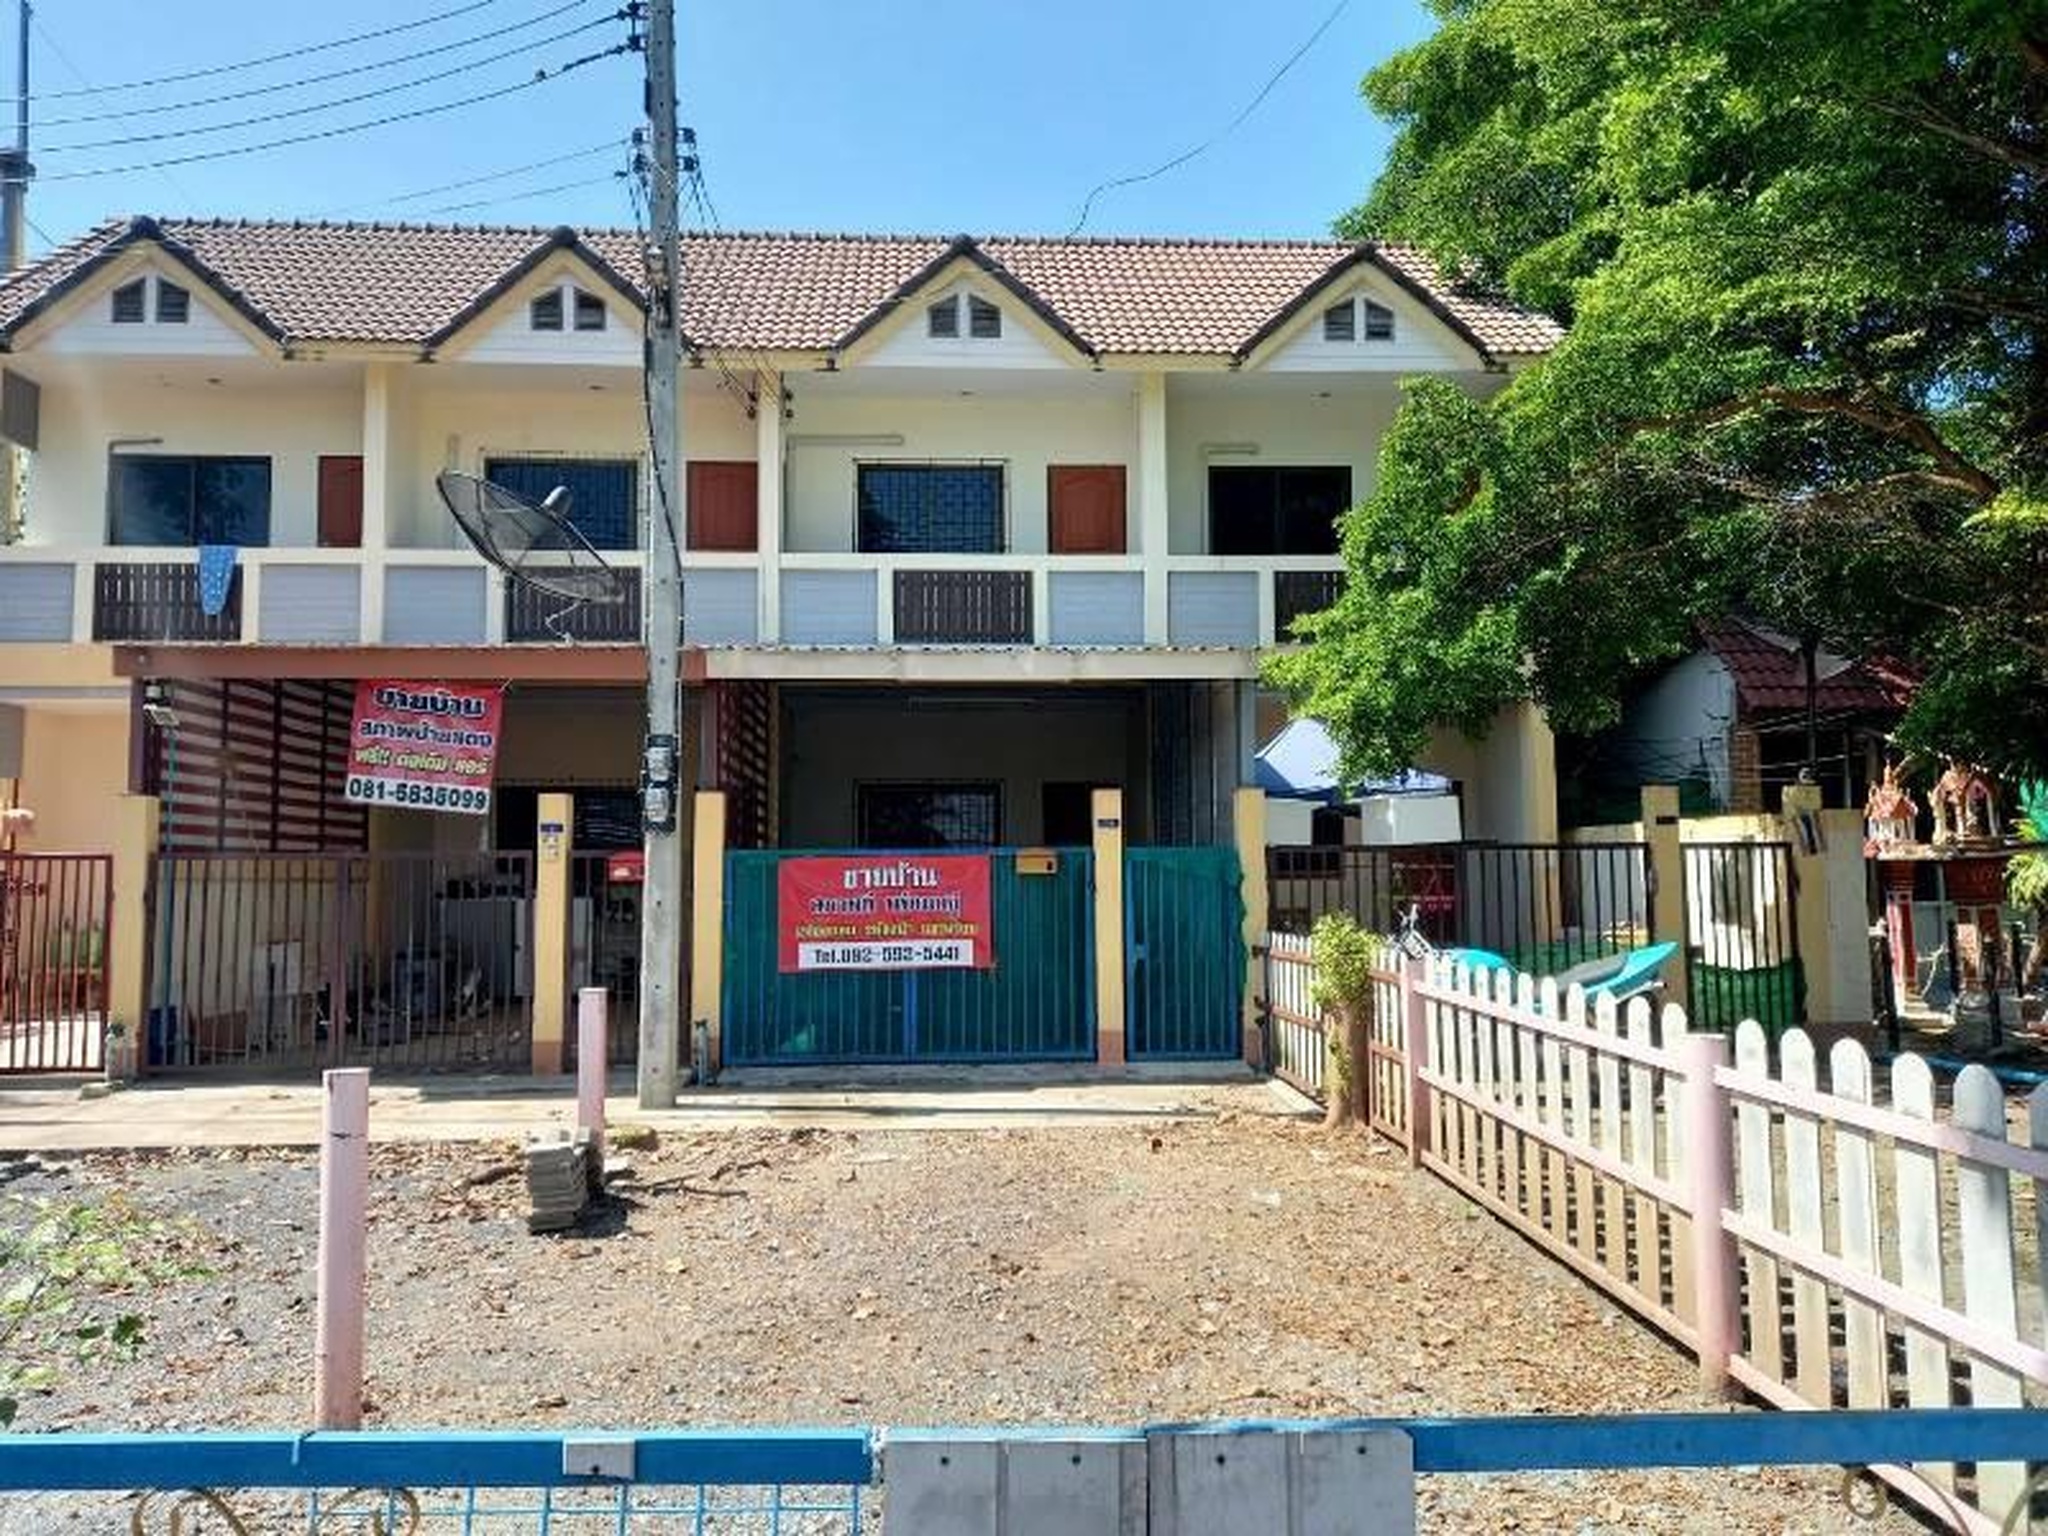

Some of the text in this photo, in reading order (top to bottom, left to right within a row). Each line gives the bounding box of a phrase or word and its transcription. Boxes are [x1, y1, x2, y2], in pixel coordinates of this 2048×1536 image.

[375, 687, 485, 718] ขายบ้าน
[843, 862, 939, 889] ขายบ้าน
